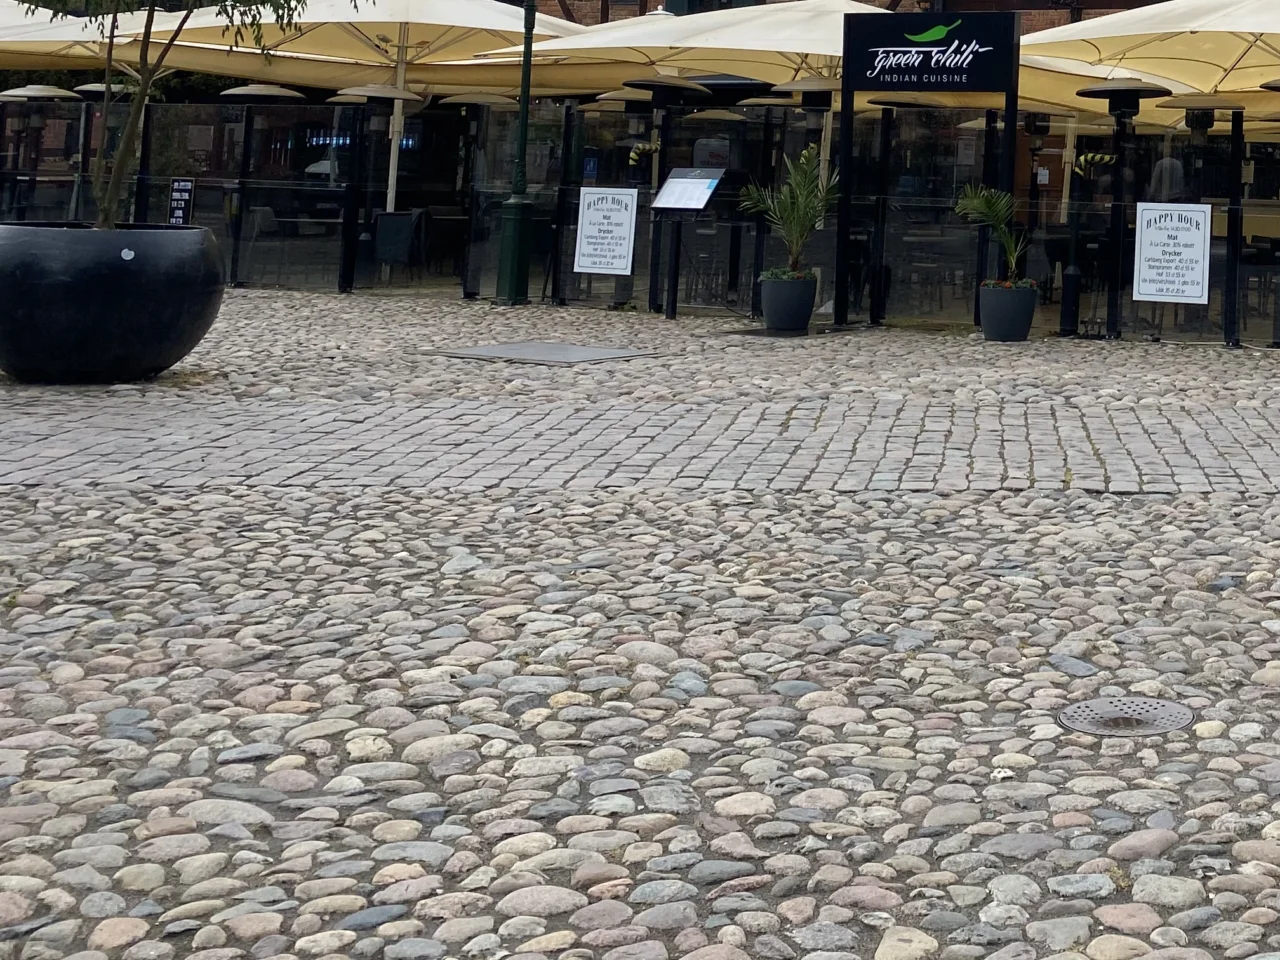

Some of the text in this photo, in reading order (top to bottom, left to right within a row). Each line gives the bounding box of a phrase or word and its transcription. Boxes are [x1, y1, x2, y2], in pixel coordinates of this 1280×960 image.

[880, 74, 968, 83] INDIAN CUISINE
[586, 196, 629, 212] HAPPY HOUR
[1146, 212, 1201, 231] HAPPY HOUR
[1167, 233, 1178, 241] Mat
[1161, 249, 1183, 257] Drycker
